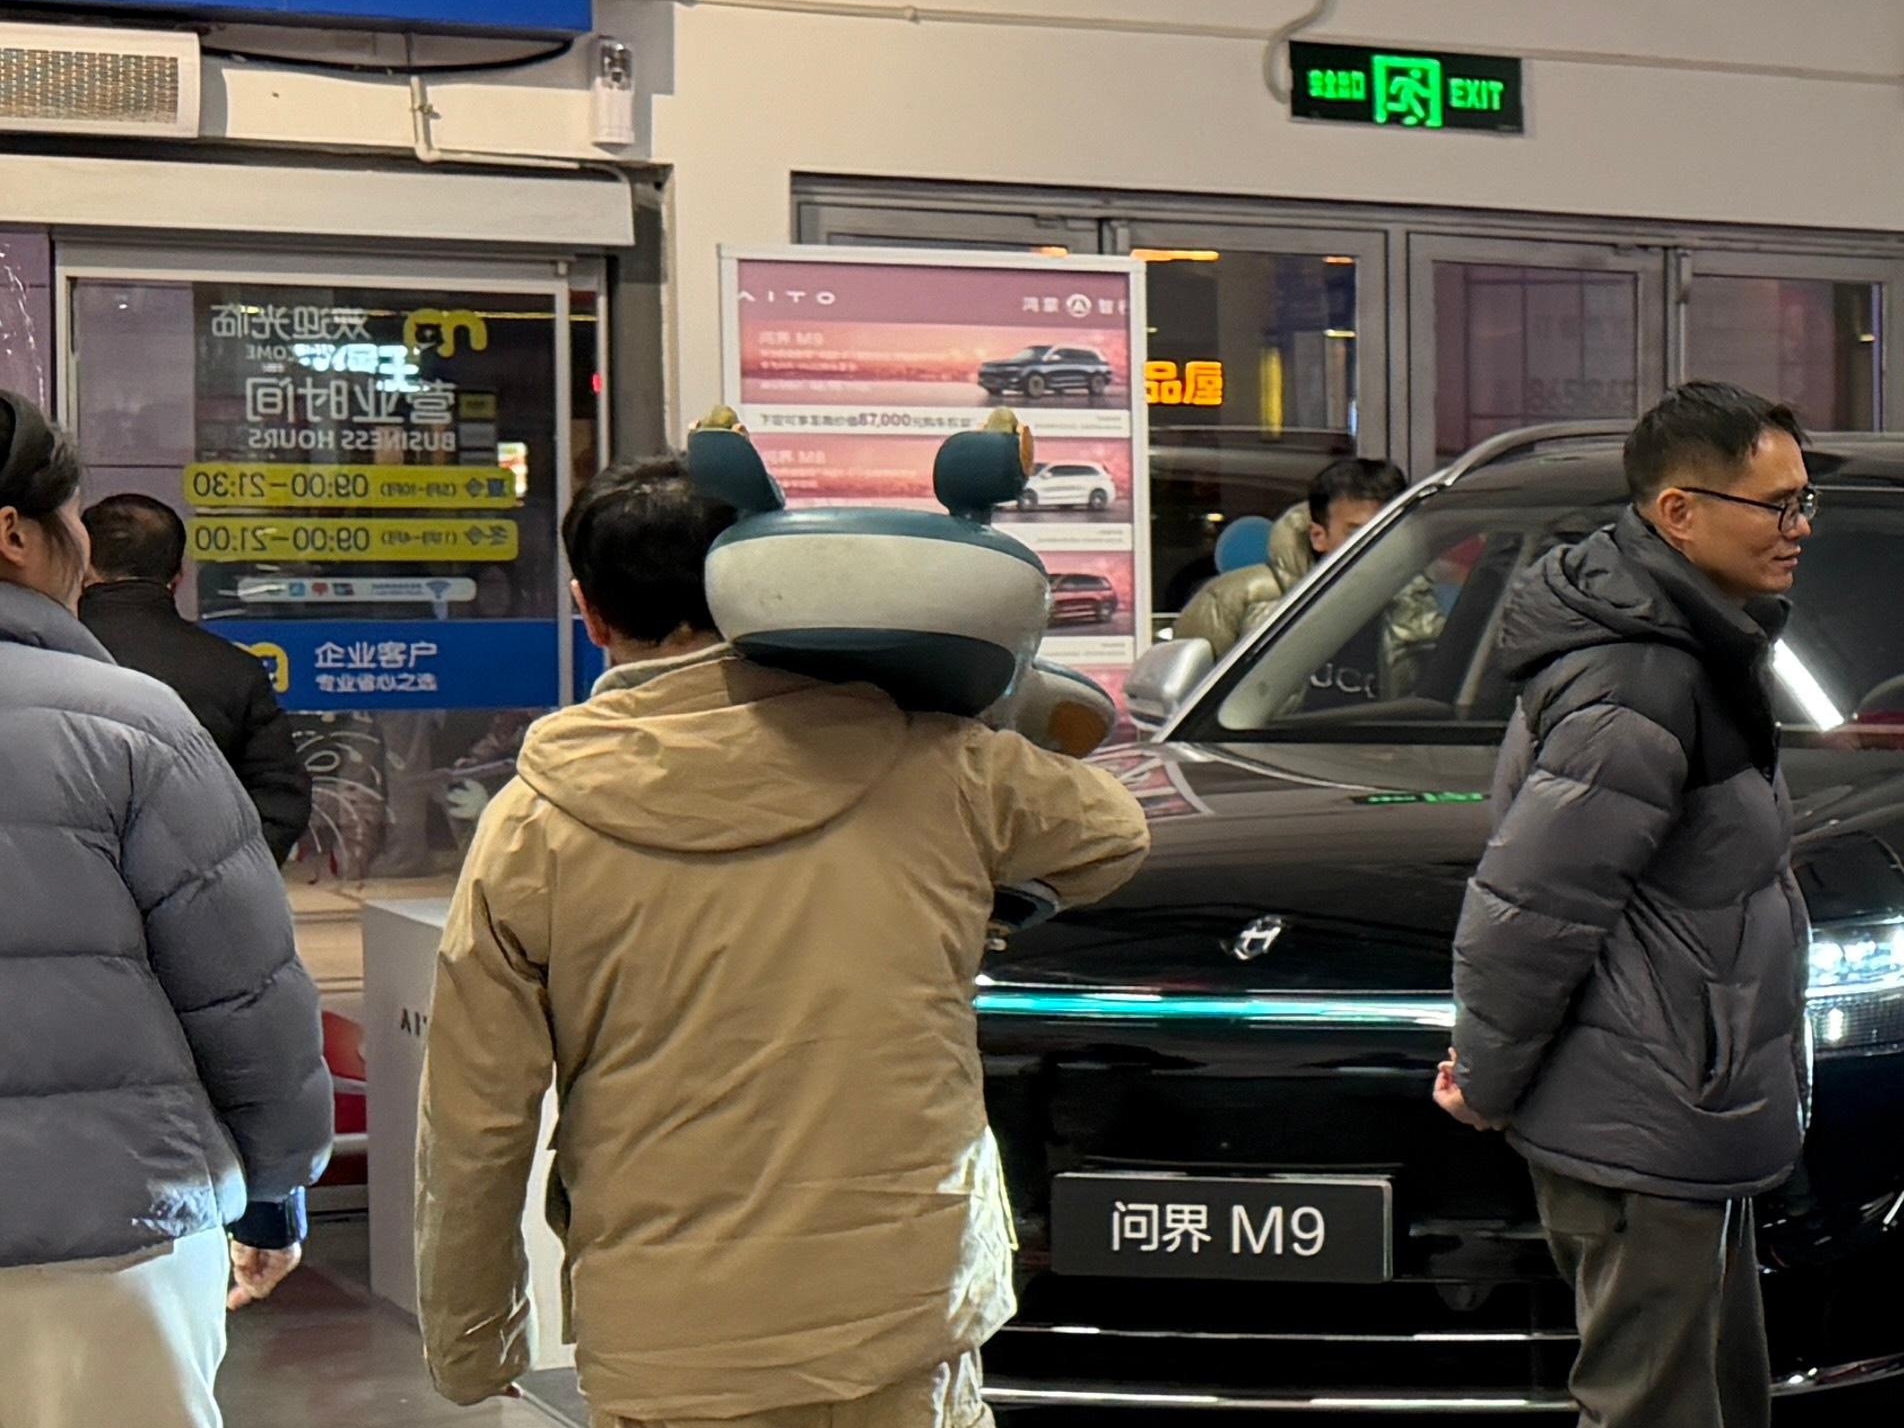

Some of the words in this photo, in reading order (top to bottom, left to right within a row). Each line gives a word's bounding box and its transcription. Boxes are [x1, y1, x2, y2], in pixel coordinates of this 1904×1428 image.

[1449, 78, 1504, 110] EXIT
[314, 641, 438, 669] 企业客户
[1112, 1200, 1213, 1255] 问界
[1231, 1203, 1326, 1257] M9
